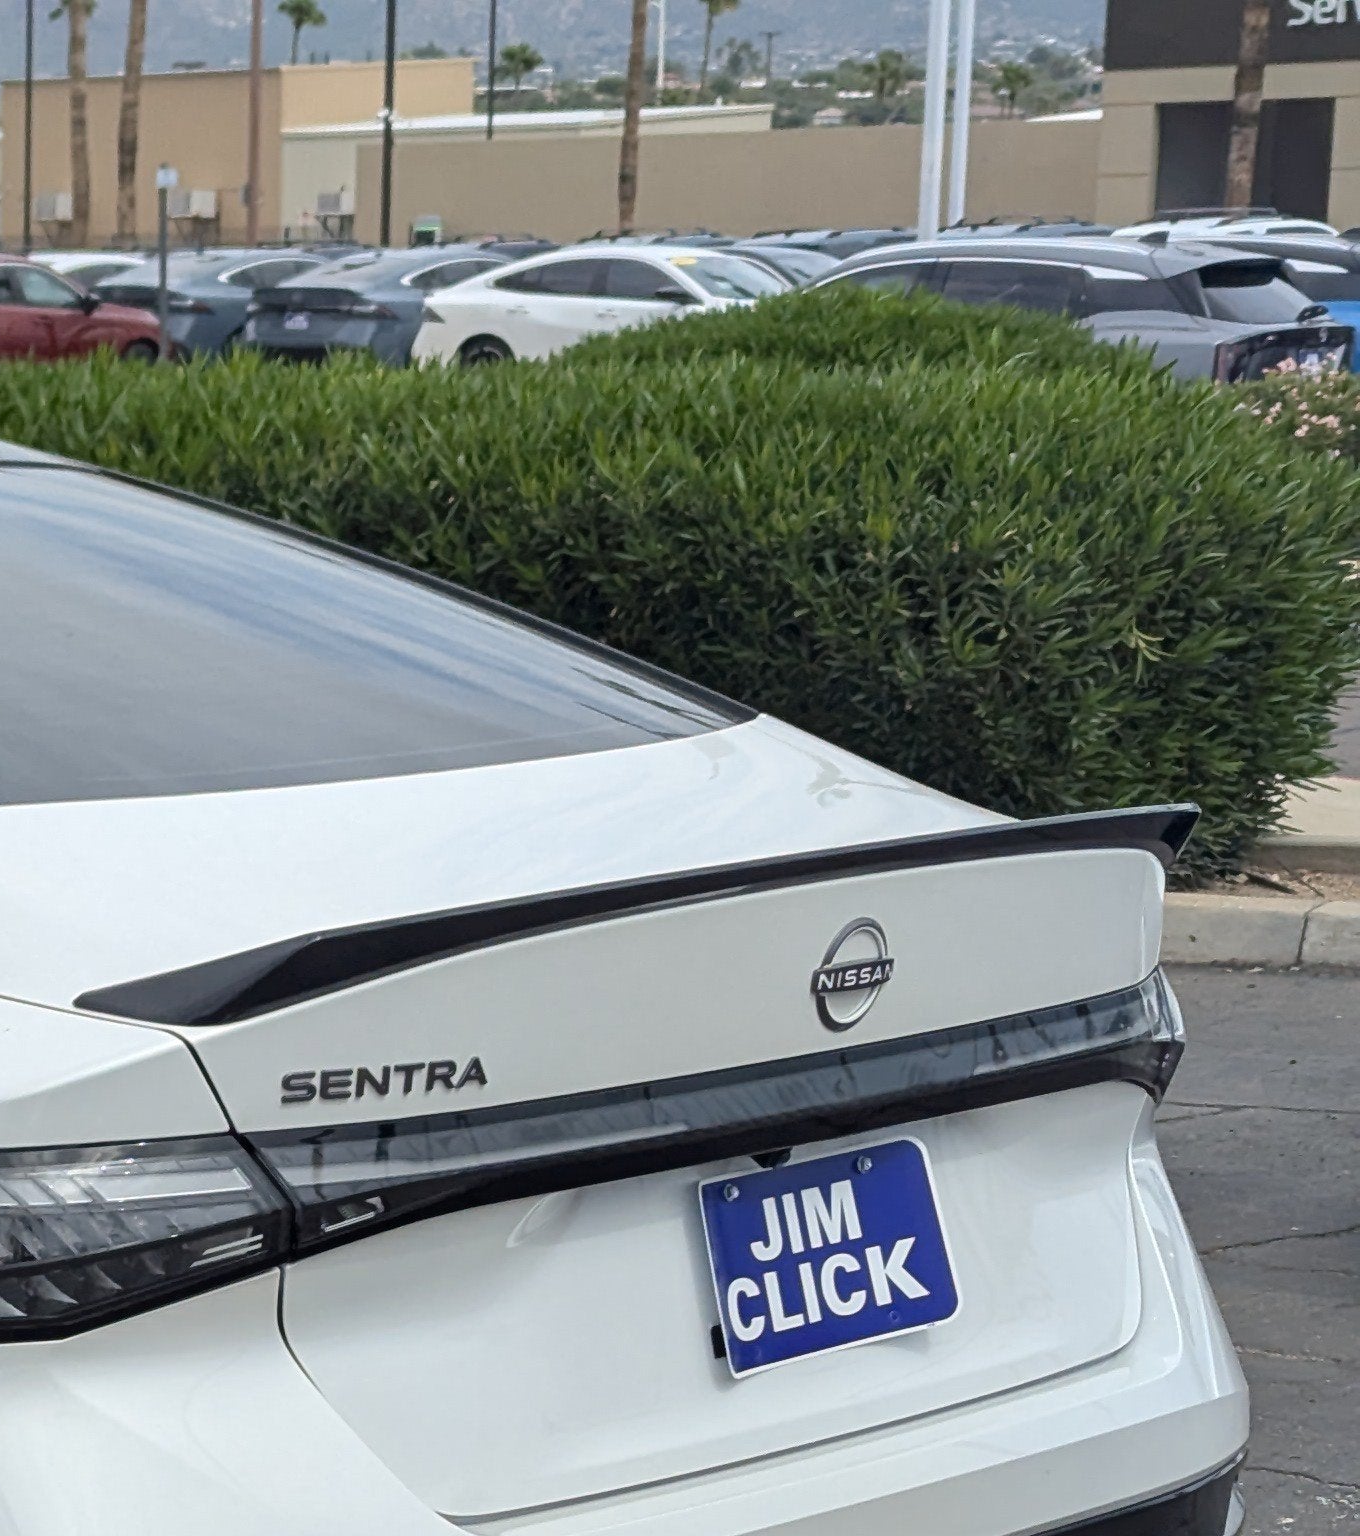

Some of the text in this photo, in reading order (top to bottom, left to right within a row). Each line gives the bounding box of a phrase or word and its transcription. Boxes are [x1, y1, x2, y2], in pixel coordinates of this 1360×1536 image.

[1286, 0, 1360, 26] Ser
[817, 963, 891, 990] NISSAN
[280, 1056, 488, 1104] SENTRA
[750, 1179, 863, 1262] JIM
[727, 1236, 931, 1342] CLICK
